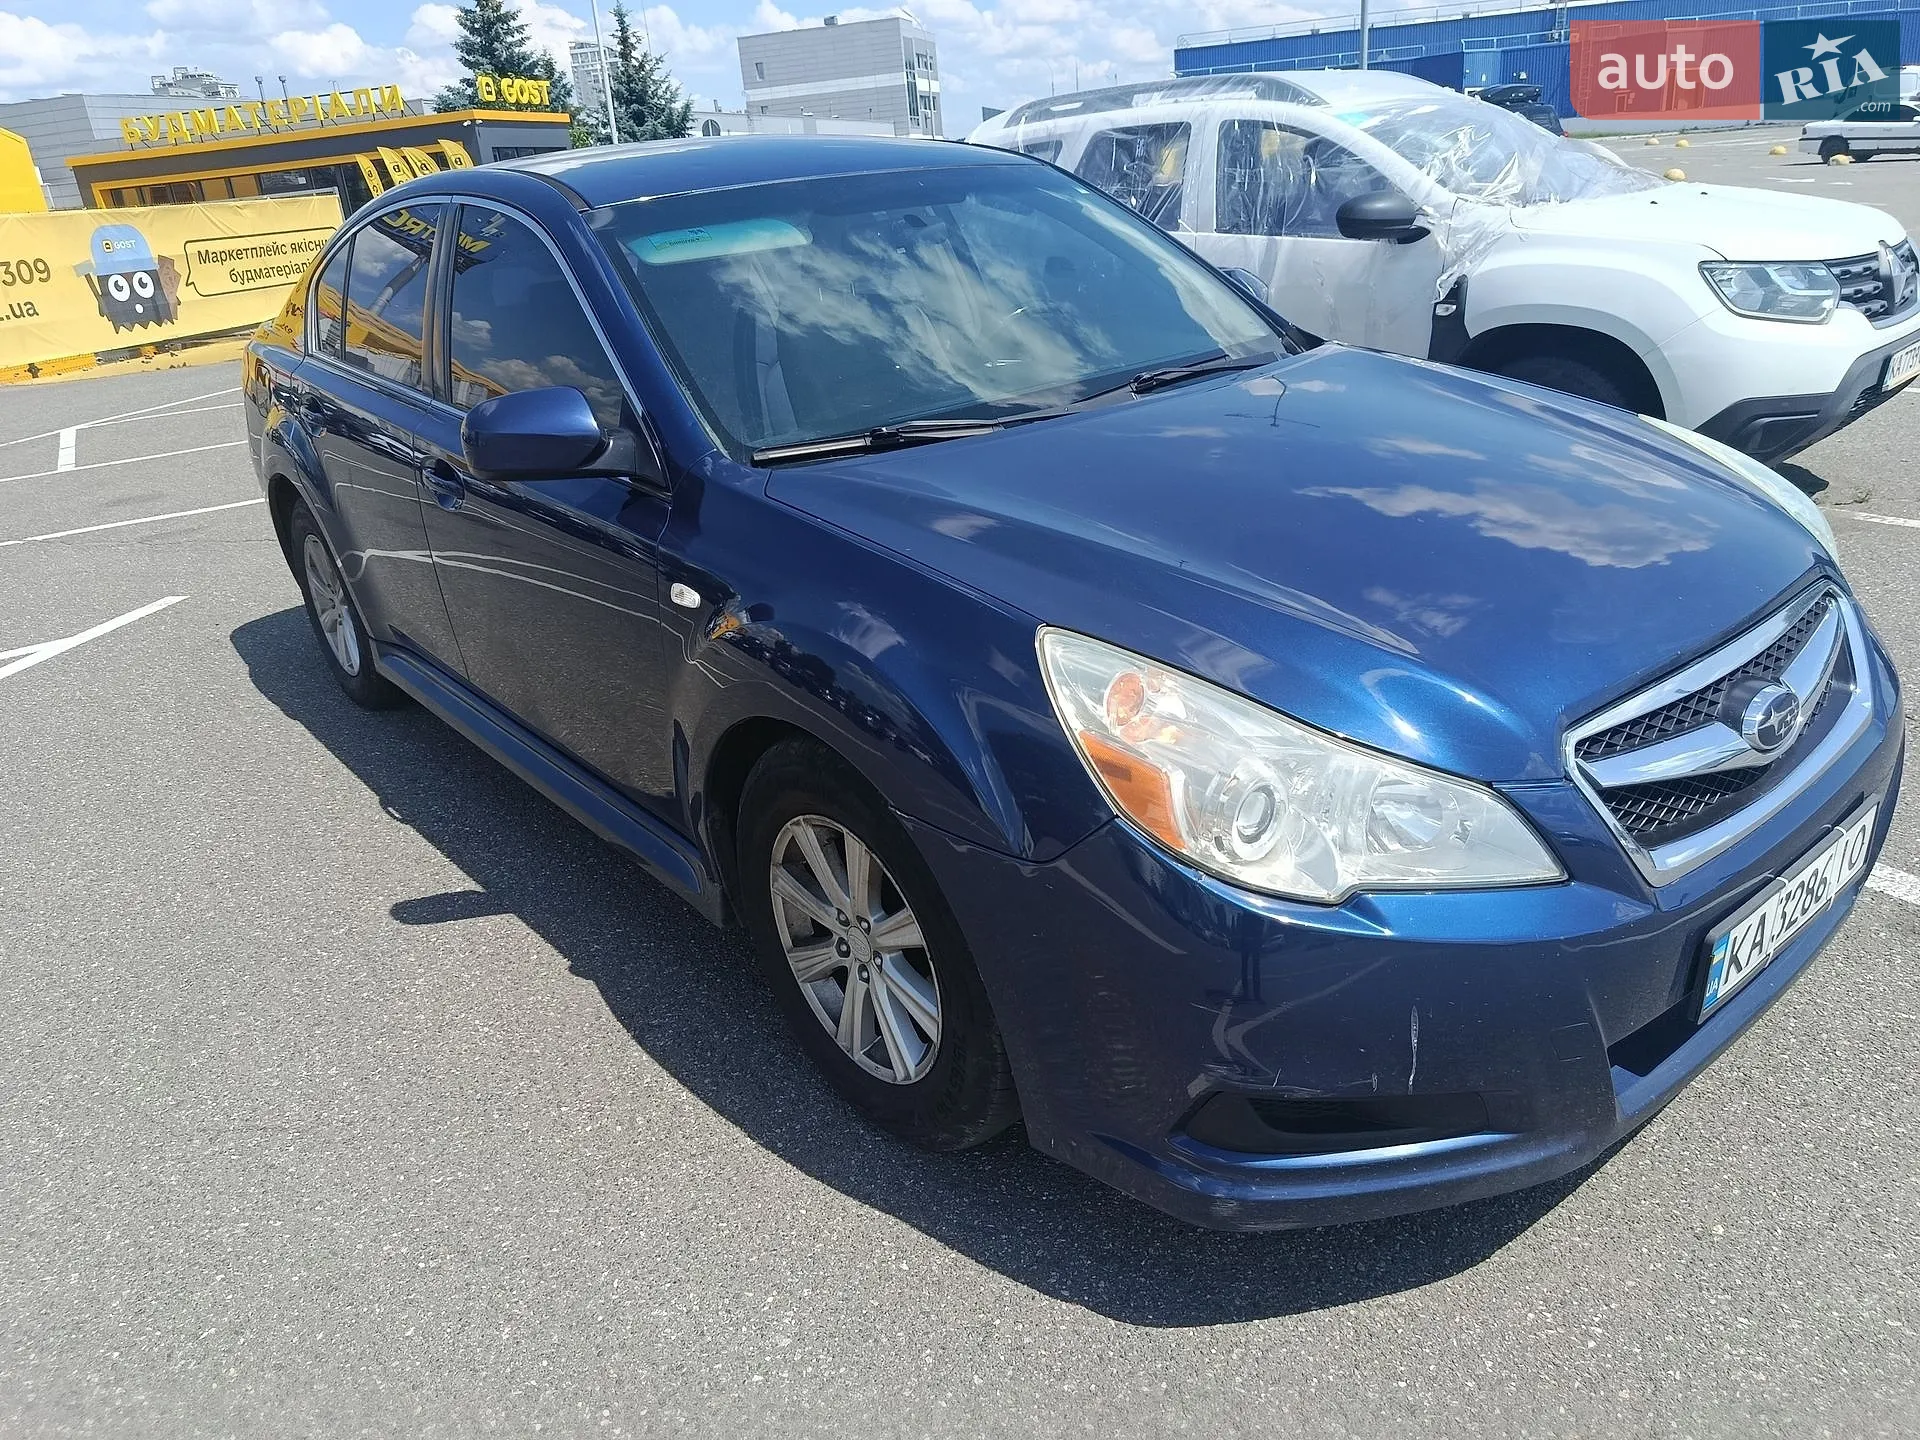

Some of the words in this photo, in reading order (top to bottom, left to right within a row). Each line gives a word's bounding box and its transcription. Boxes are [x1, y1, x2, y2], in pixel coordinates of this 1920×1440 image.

[501, 77, 550, 106] GOST
[119, 84, 403, 144] БУДМАТЕРІАЛИ
[114, 239, 136, 250] GOST
[197, 242, 288, 266] Маркетплейс
